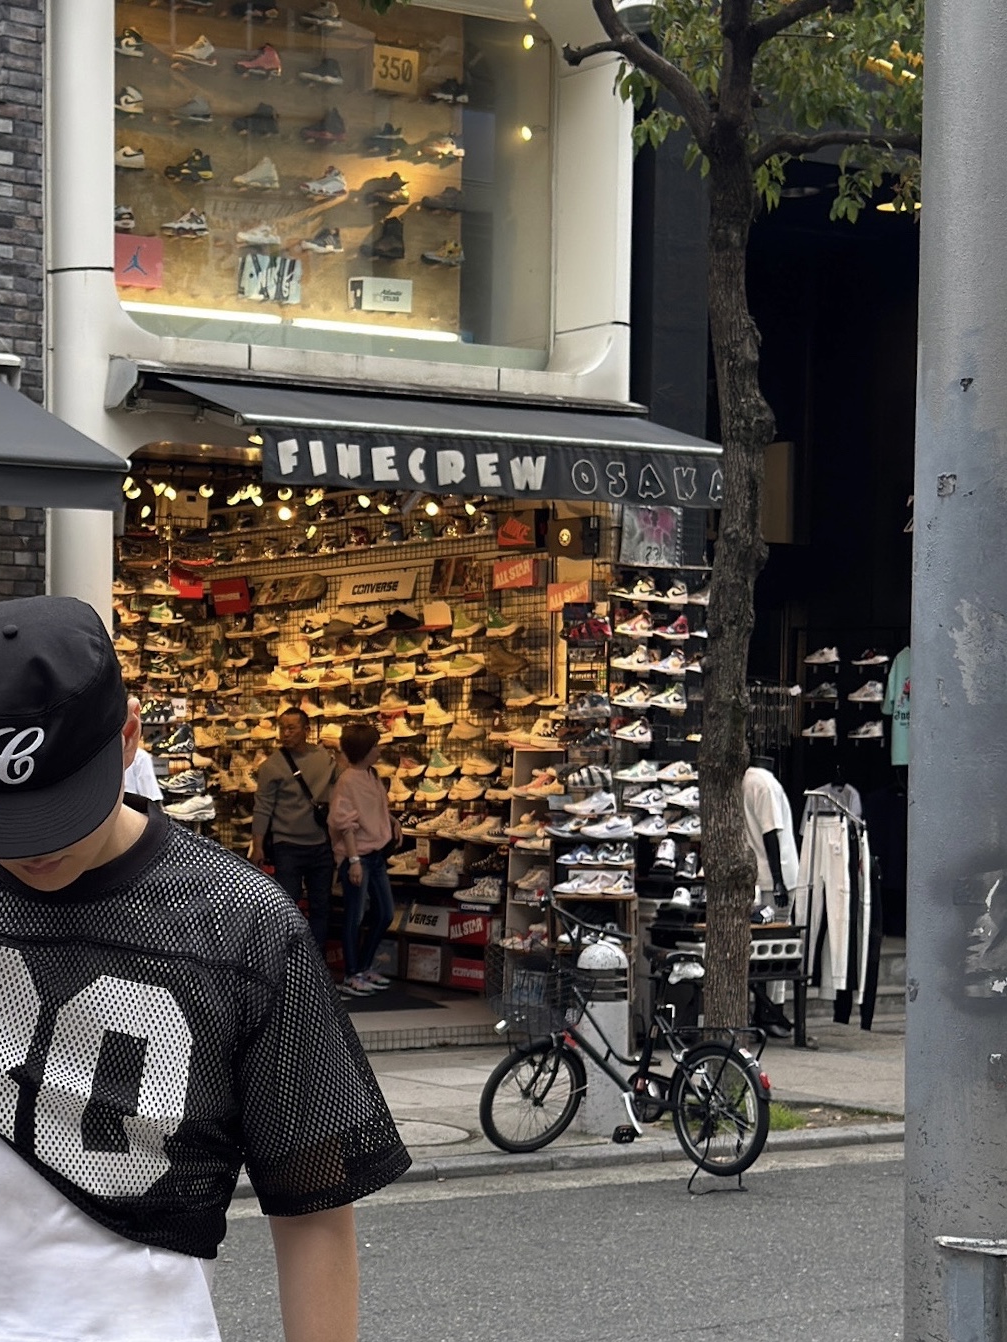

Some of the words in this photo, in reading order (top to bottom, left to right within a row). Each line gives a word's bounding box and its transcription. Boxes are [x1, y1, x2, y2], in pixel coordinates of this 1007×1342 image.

[378, 54, 413, 82] 350
[277, 438, 546, 491] FINECREW
[509, 560, 531, 582] STAR
[352, 581, 399, 596] CONVERSE
[462, 917, 484, 934] STAR
